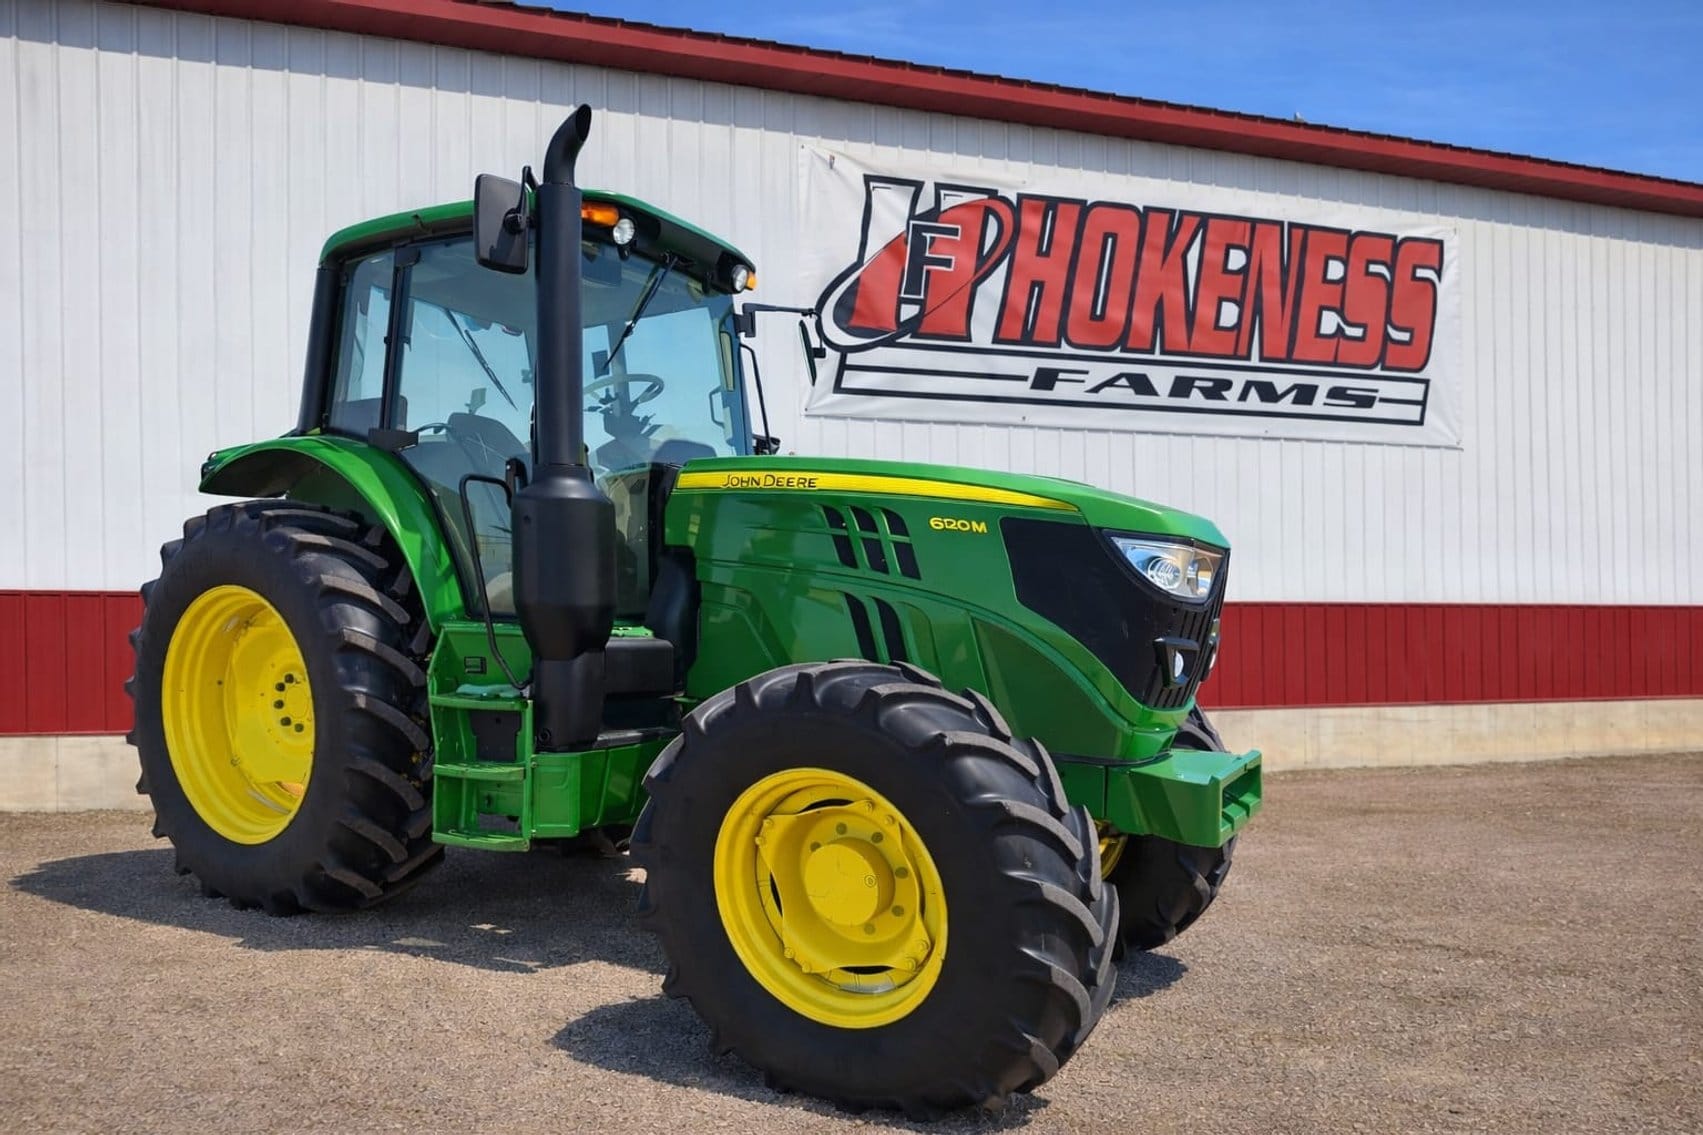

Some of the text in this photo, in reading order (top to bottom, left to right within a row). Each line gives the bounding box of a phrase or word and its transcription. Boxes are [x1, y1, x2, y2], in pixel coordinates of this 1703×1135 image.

[1029, 367, 1380, 409] FARMS
[722, 474, 819, 489] JOHN DEERE
